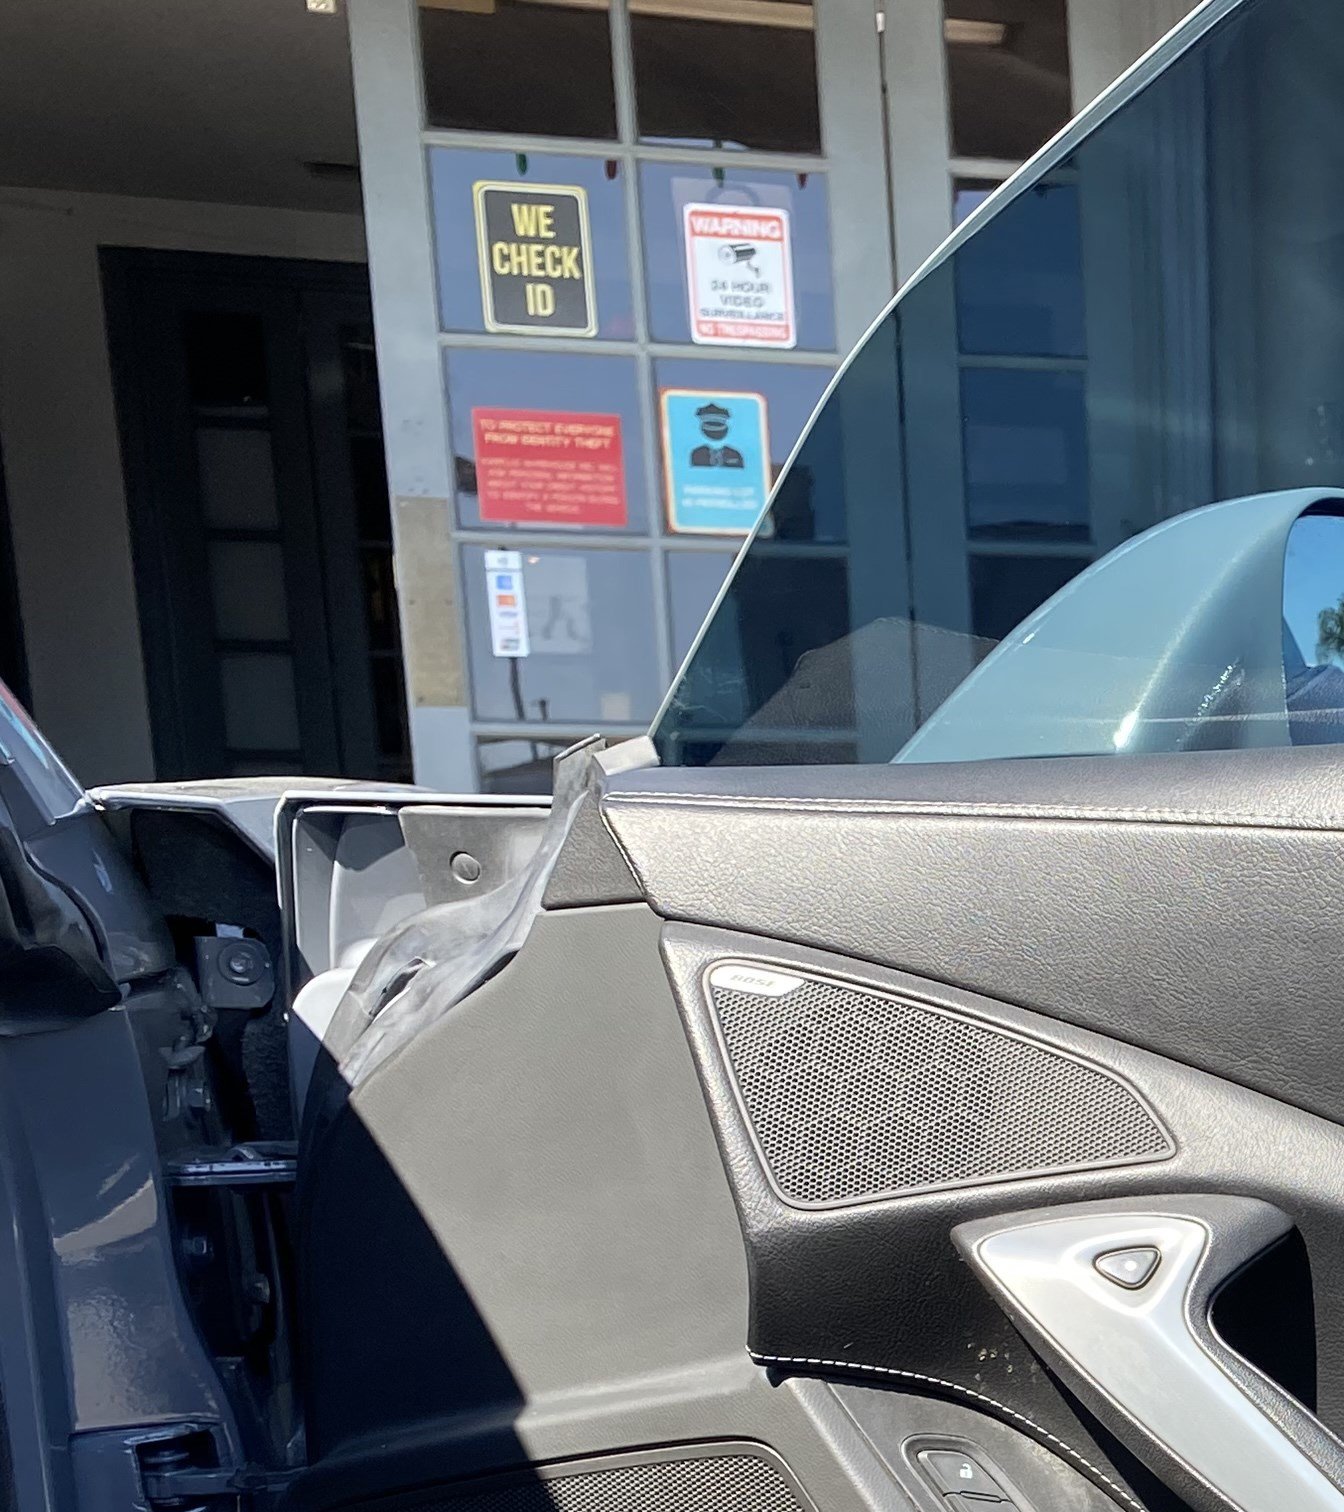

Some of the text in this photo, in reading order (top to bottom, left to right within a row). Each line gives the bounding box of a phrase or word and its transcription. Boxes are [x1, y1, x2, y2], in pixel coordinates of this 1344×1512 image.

[511, 203, 556, 238] WE
[691, 216, 781, 239] WARNING
[492, 241, 582, 279] CHECK
[711, 280, 769, 294] 24 HOUR
[525, 283, 555, 317] ID
[720, 295, 765, 308] VIDEO
[700, 308, 784, 321] SURVEILLANCE
